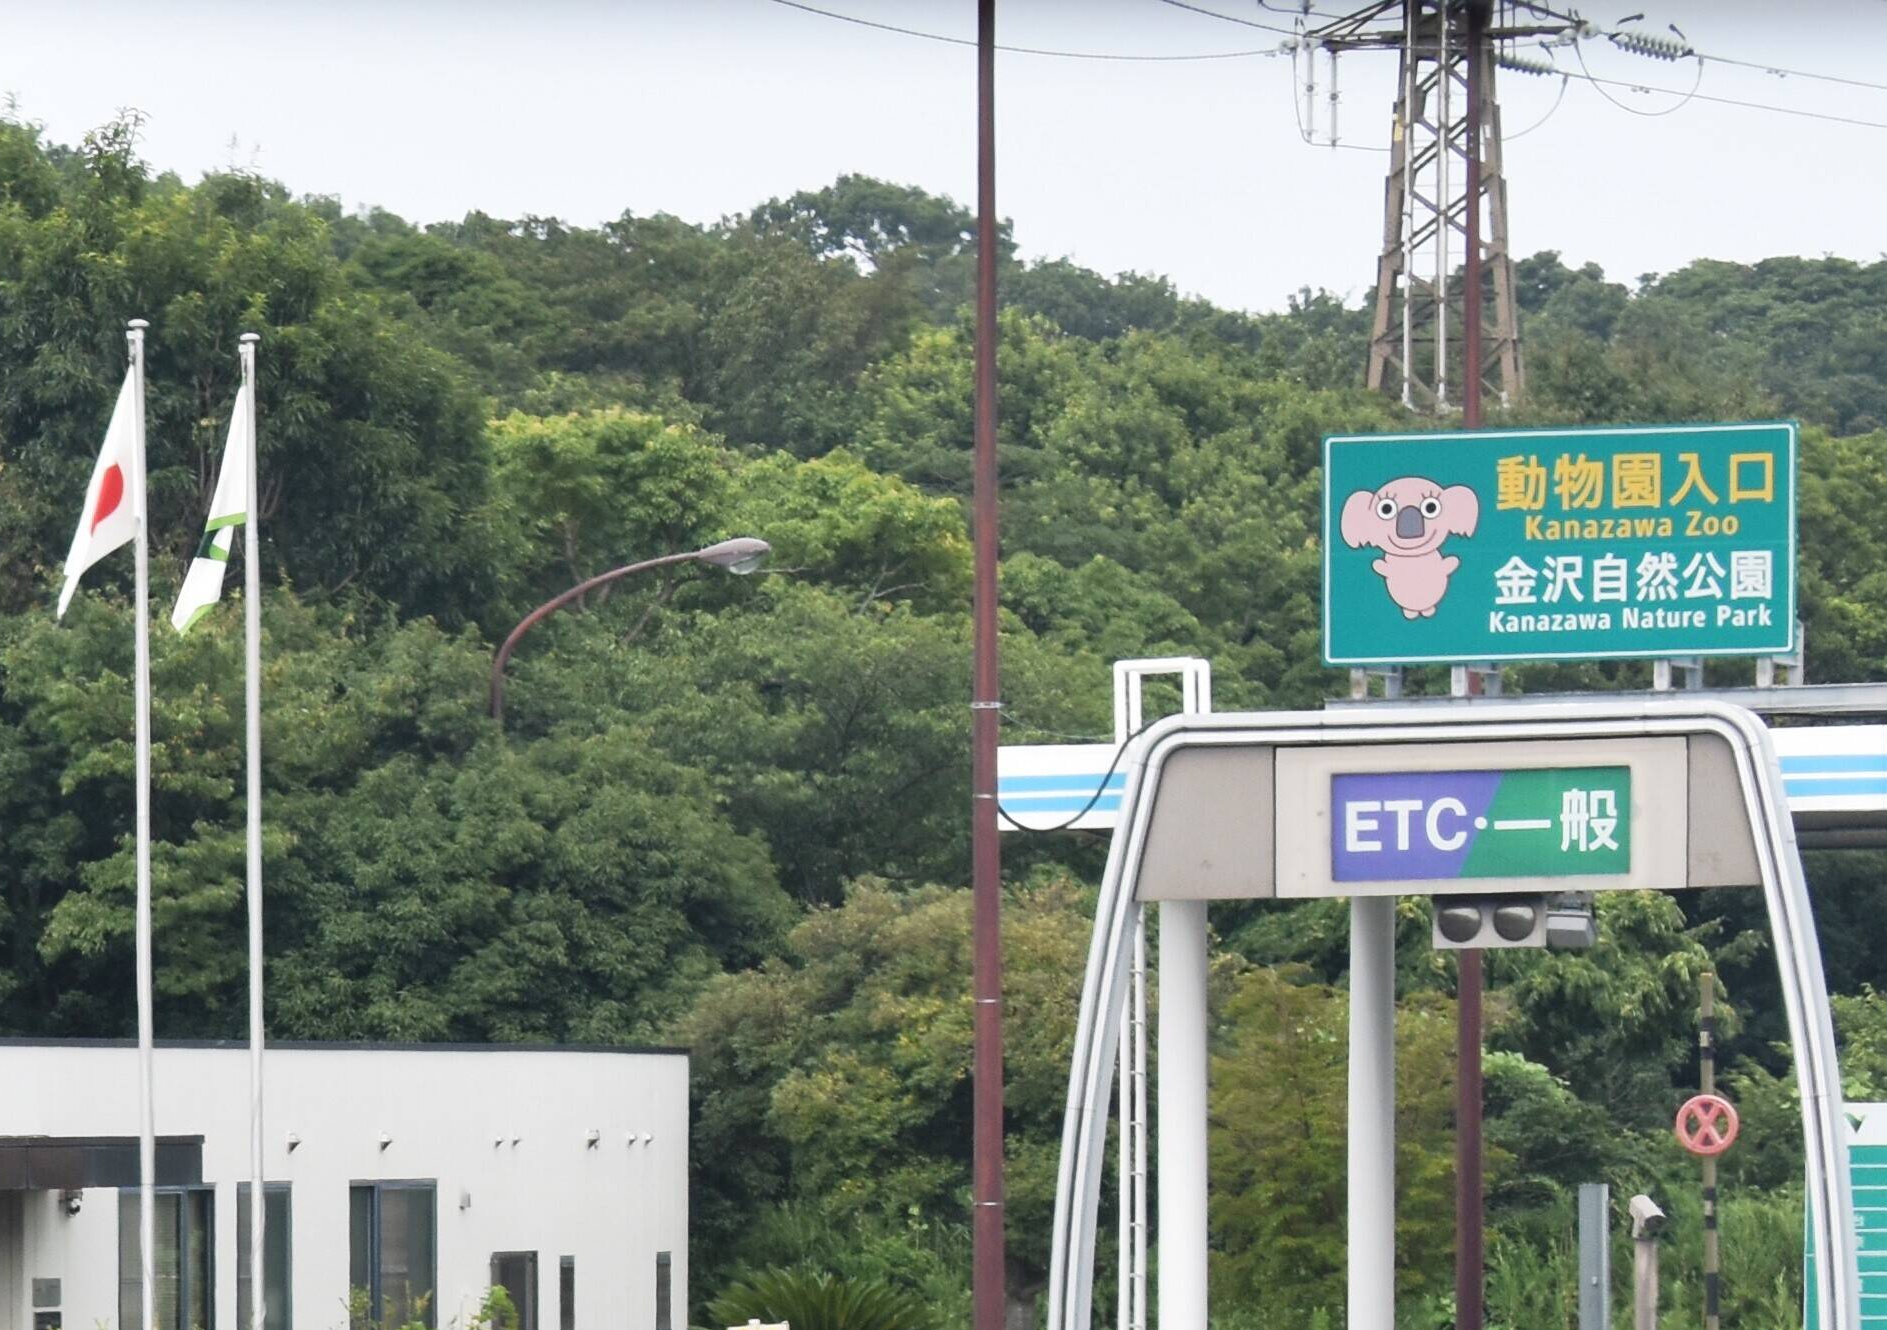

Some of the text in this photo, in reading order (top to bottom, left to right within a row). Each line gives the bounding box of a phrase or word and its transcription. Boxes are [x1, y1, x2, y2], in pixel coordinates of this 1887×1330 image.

[1496, 452, 1774, 511] 動物園入口
[1525, 511, 1739, 541] Kanazawa Zoo
[1494, 550, 1773, 604] 金沢自然公園
[1489, 603, 1773, 633] Kanazawa Nature Park
